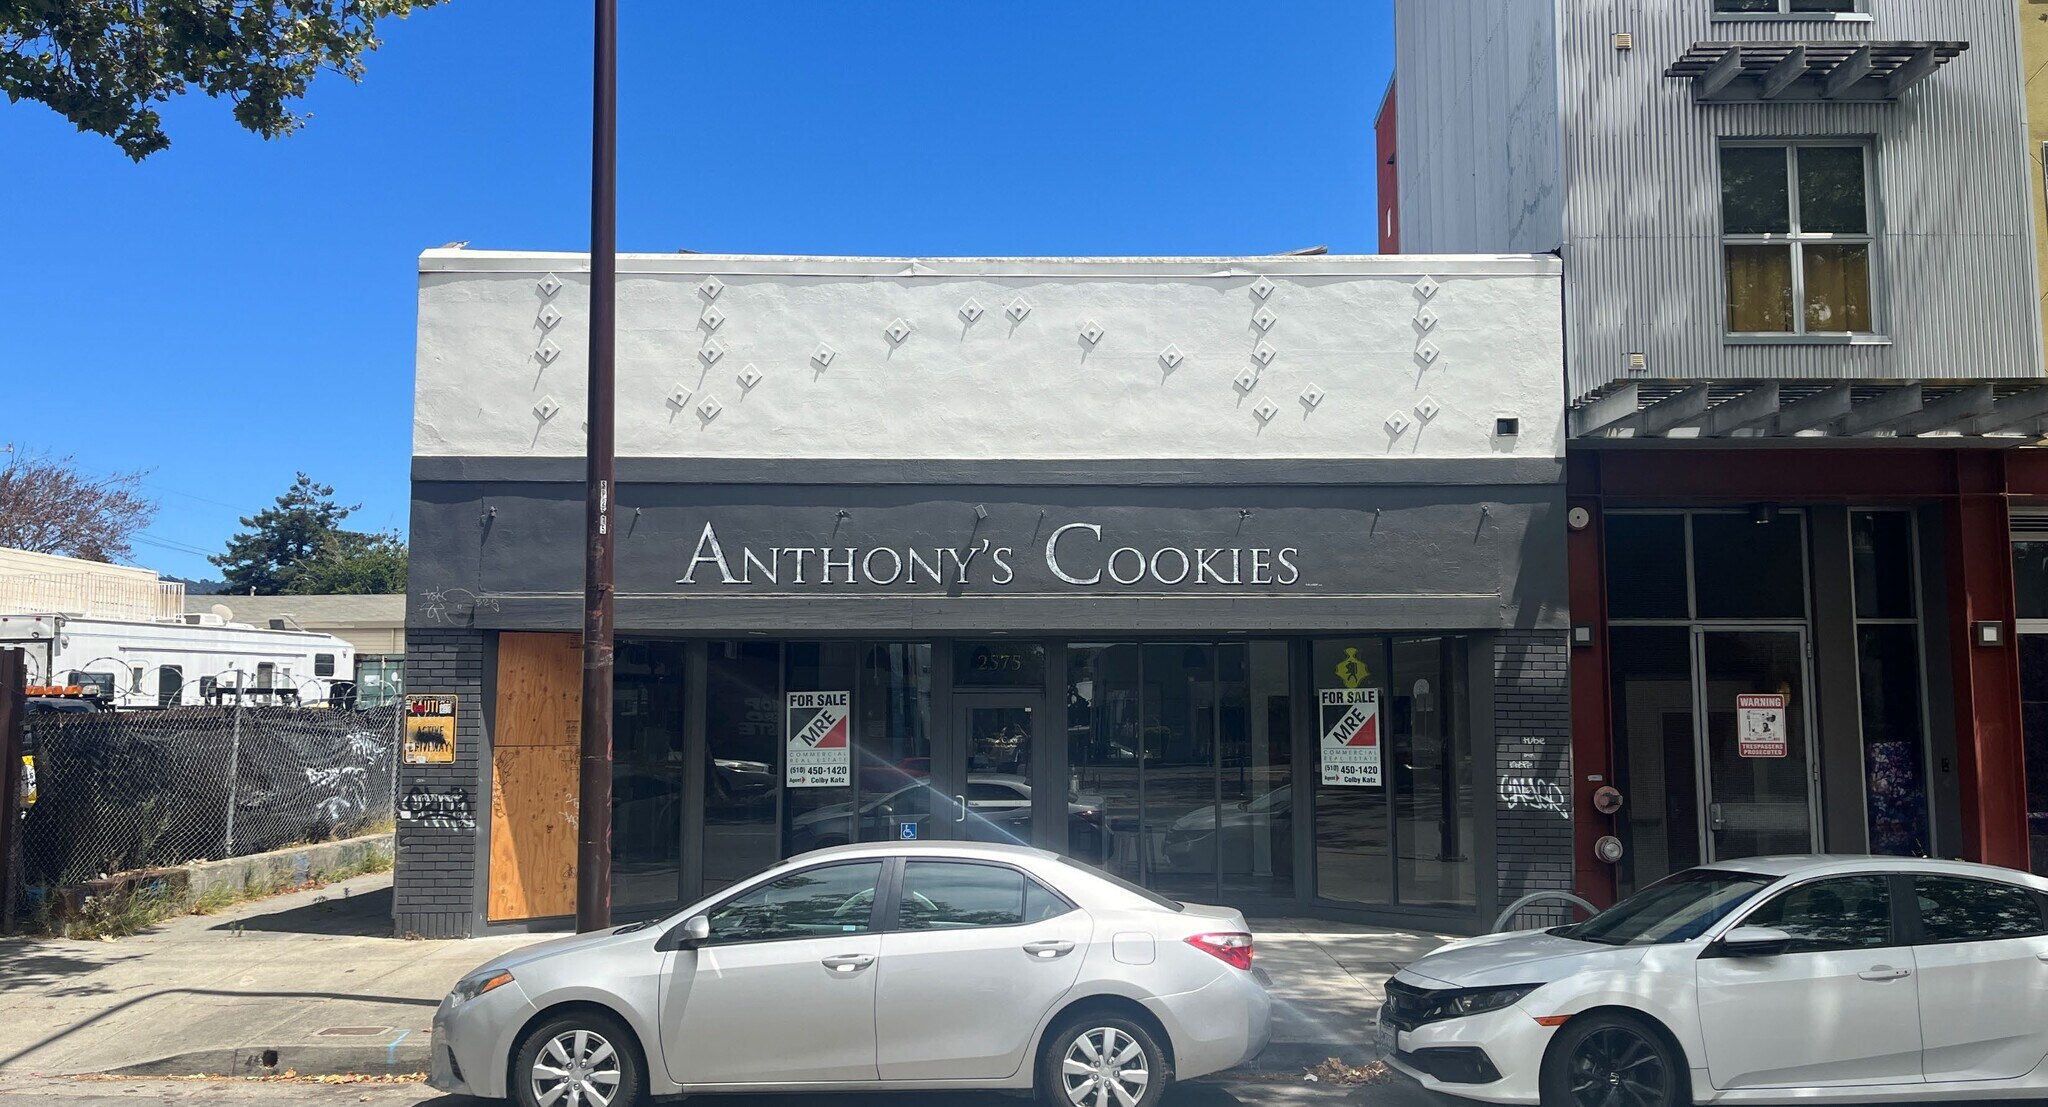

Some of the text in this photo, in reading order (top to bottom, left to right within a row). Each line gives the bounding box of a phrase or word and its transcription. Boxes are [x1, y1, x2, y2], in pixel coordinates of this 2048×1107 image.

[675, 521, 1300, 585] ANTHONY'S COOKIES
[977, 654, 1022, 671] 2575
[790, 694, 846, 706] FOR SALE
[1322, 691, 1375, 704] FOR SALE
[1740, 697, 1782, 707] WARNING
[800, 709, 836, 747] MRE
[1333, 707, 1366, 745] MRE
[790, 766, 847, 775] (510) 450-1420
[1341, 765, 1378, 775] 450-1420
[811, 777, 829, 785] Colby
[1344, 776, 1361, 784] Colby
